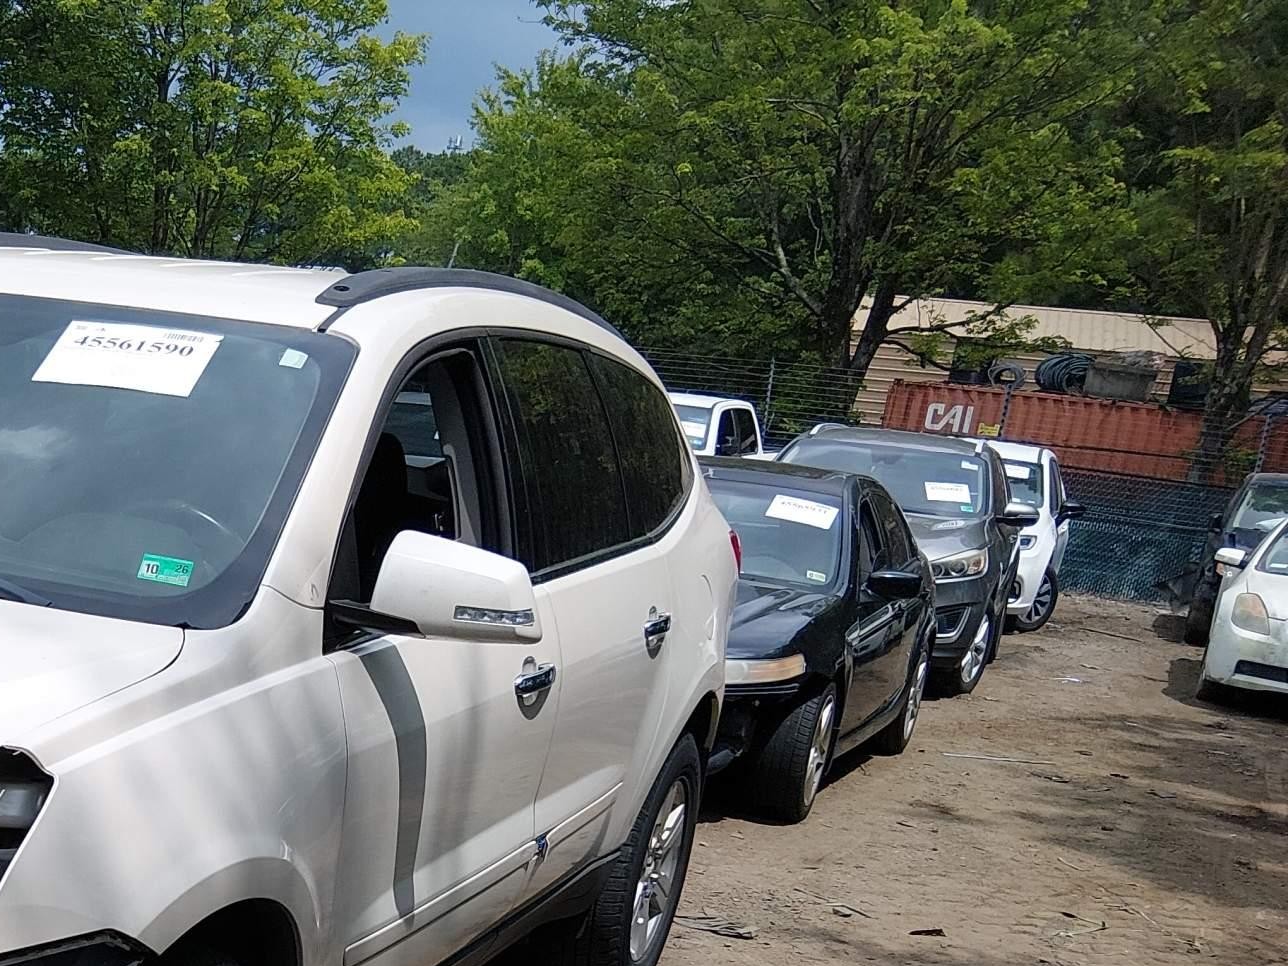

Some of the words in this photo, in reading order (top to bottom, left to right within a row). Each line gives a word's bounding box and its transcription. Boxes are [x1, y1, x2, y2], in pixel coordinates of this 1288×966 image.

[73, 335, 194, 357] 45561590
[924, 403, 974, 433] CAI
[144, 563, 159, 575] 10
[174, 564, 189, 574] 26
